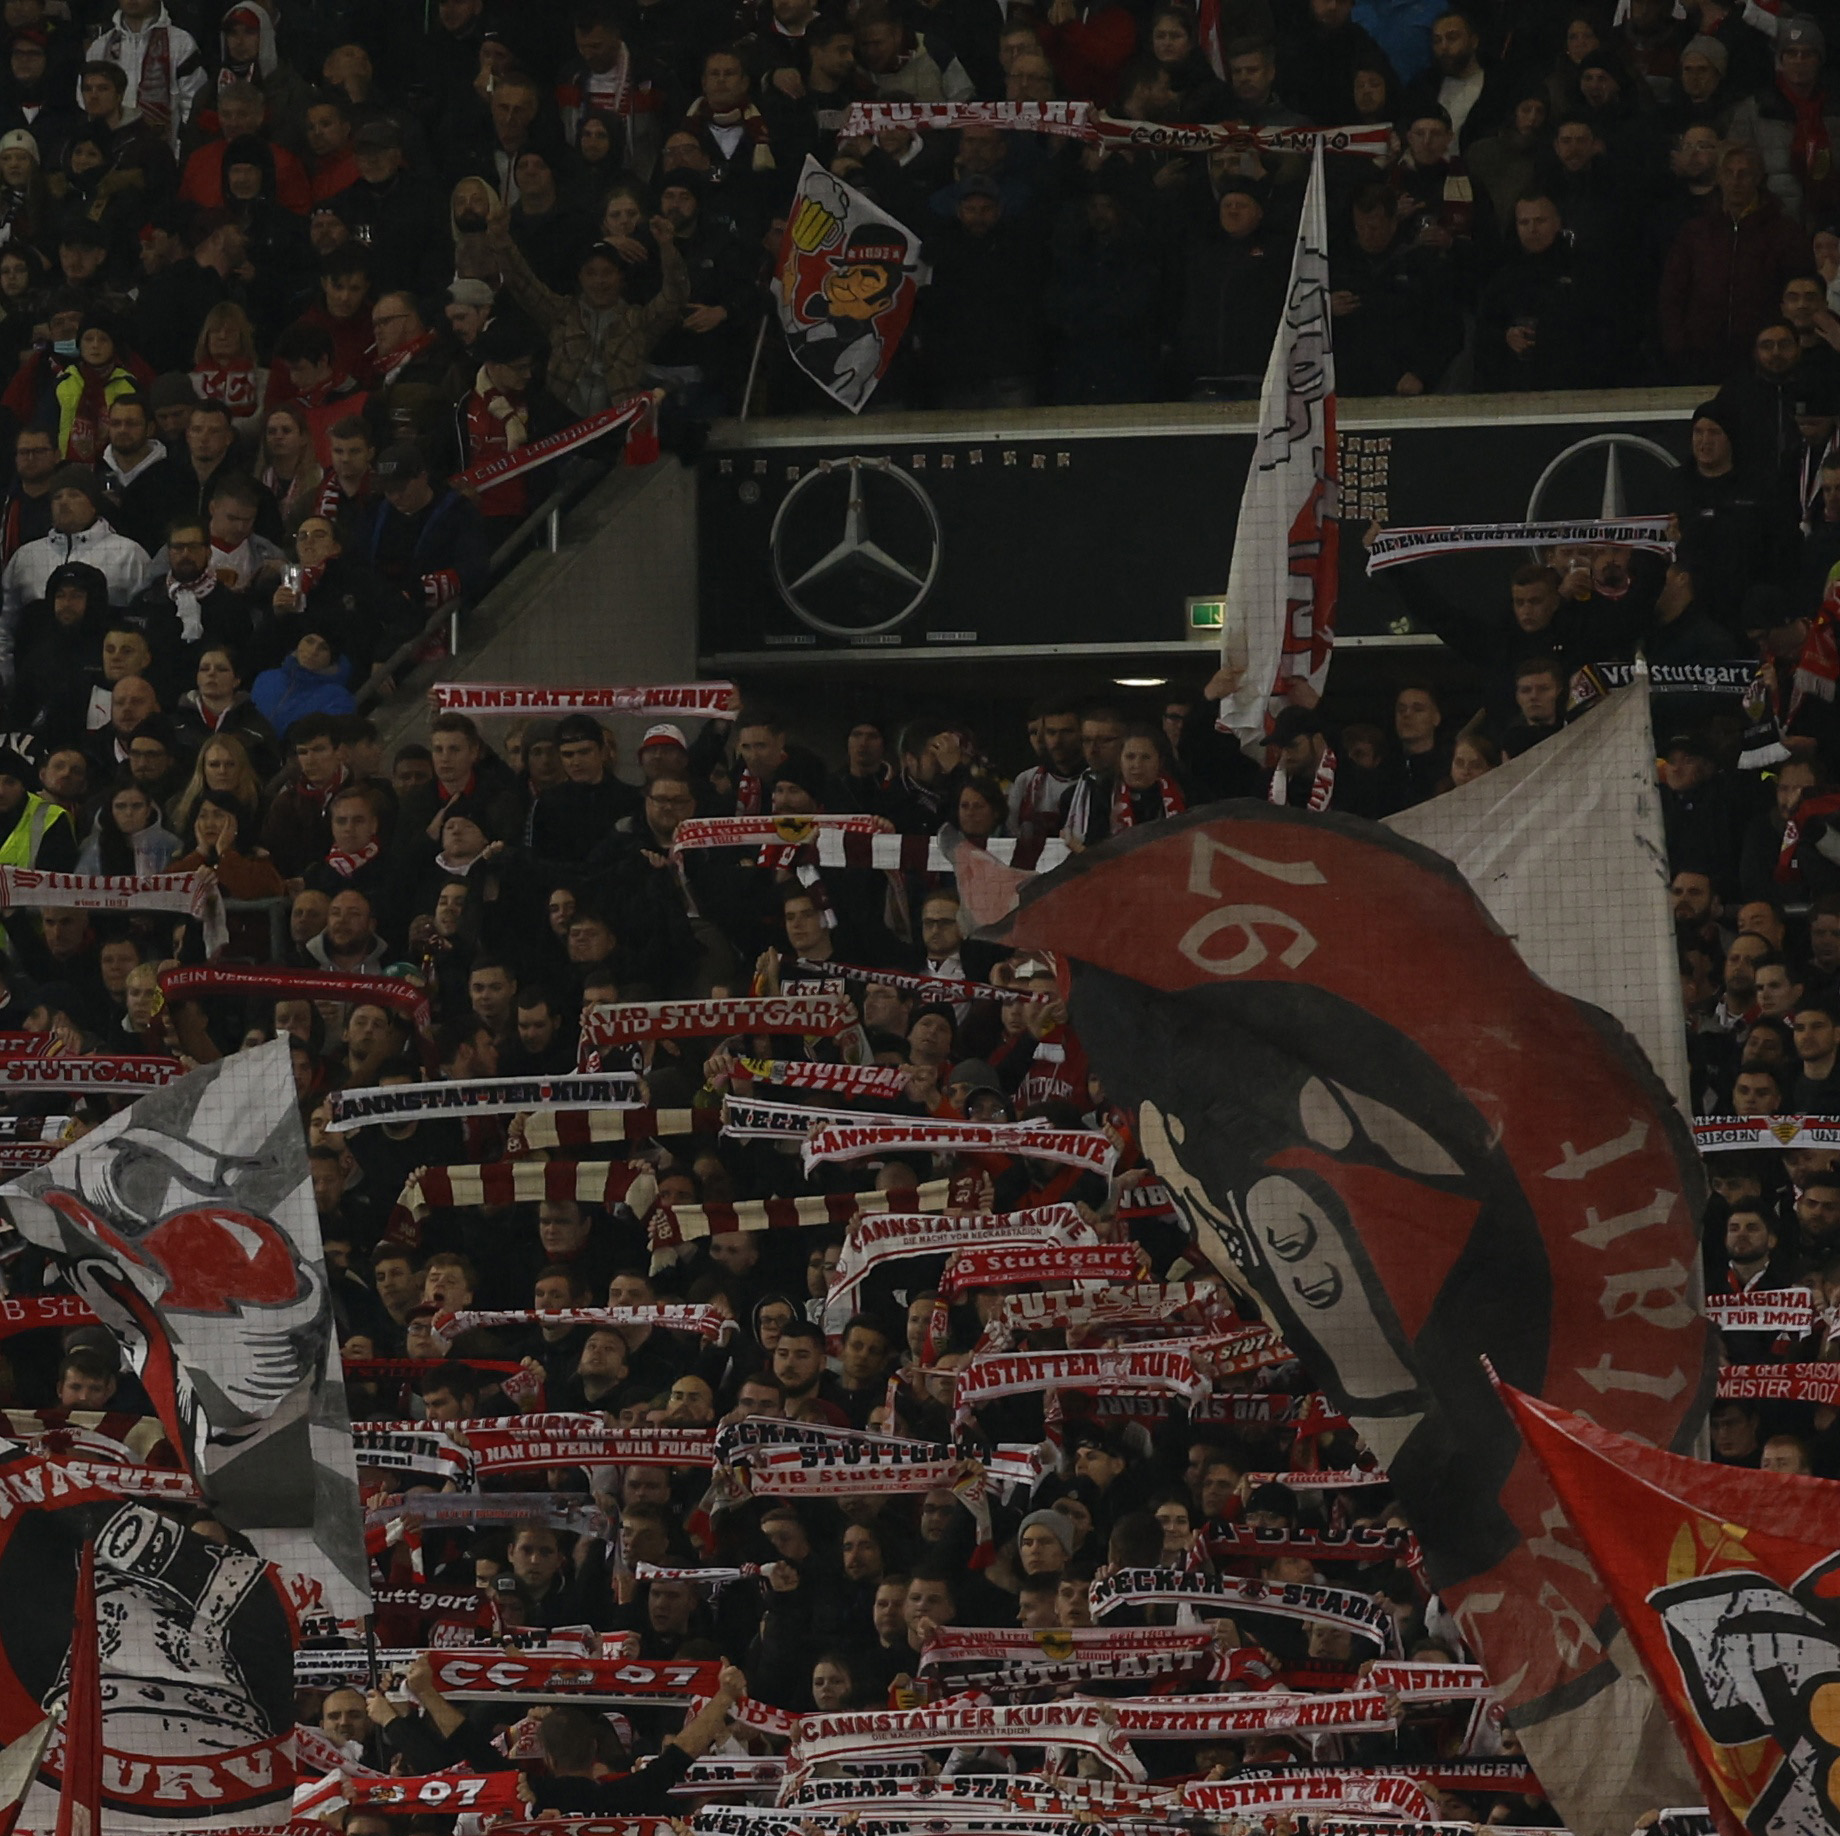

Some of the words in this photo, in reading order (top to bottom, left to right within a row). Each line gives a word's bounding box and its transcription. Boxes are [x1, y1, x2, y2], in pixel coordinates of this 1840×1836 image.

[1370, 533, 1396, 557] DIE
[642, 686, 733, 709] KURVE
[660, 995, 853, 1036] STUTTGART
[1020, 1128, 1109, 1164] KURVE
[1695, 1127, 1760, 1145] SIEGEN
[850, 1209, 1016, 1254] CANNSTATTER
[1019, 1203, 1089, 1240] KURVE
[985, 1249, 1134, 1271] Stuttgart
[1727, 1310, 1759, 1326] FÜR
[1716, 1378, 1792, 1400] MEISTER
[1796, 1380, 1838, 1403] 2007
[607, 1439, 649, 1458] WIR
[754, 1468, 808, 1486] VfB
[437, 1658, 531, 1689] CC
[1297, 1697, 1388, 1726] KURVE
[800, 1705, 996, 1743] CANNSTATTER
[1004, 1705, 1101, 1729] KURVE
[1282, 1766, 1361, 1781] IMMER
[1373, 1762, 1528, 1782] REUTLINGEN
